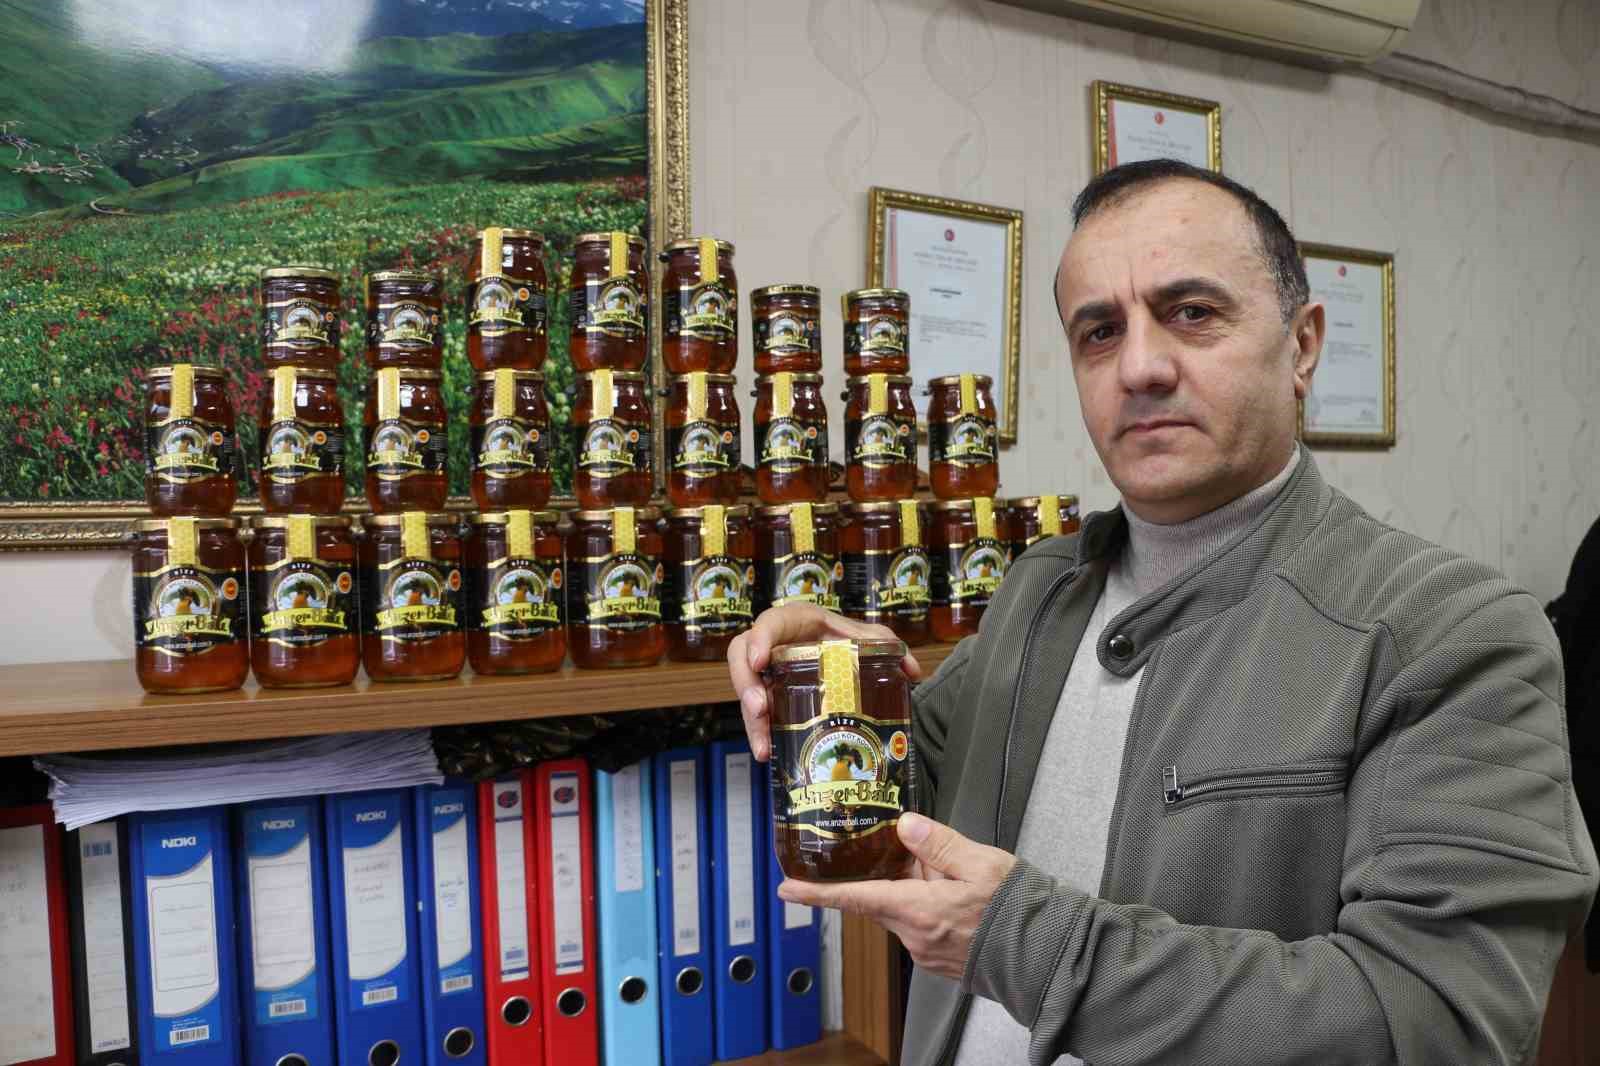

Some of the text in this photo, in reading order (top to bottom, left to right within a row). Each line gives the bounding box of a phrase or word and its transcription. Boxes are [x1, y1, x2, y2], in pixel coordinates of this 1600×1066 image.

[434, 803, 464, 815] NOKI
[355, 810, 387, 823] NOKI
[262, 818, 296, 831] NOKI
[161, 836, 197, 849] NOKI
